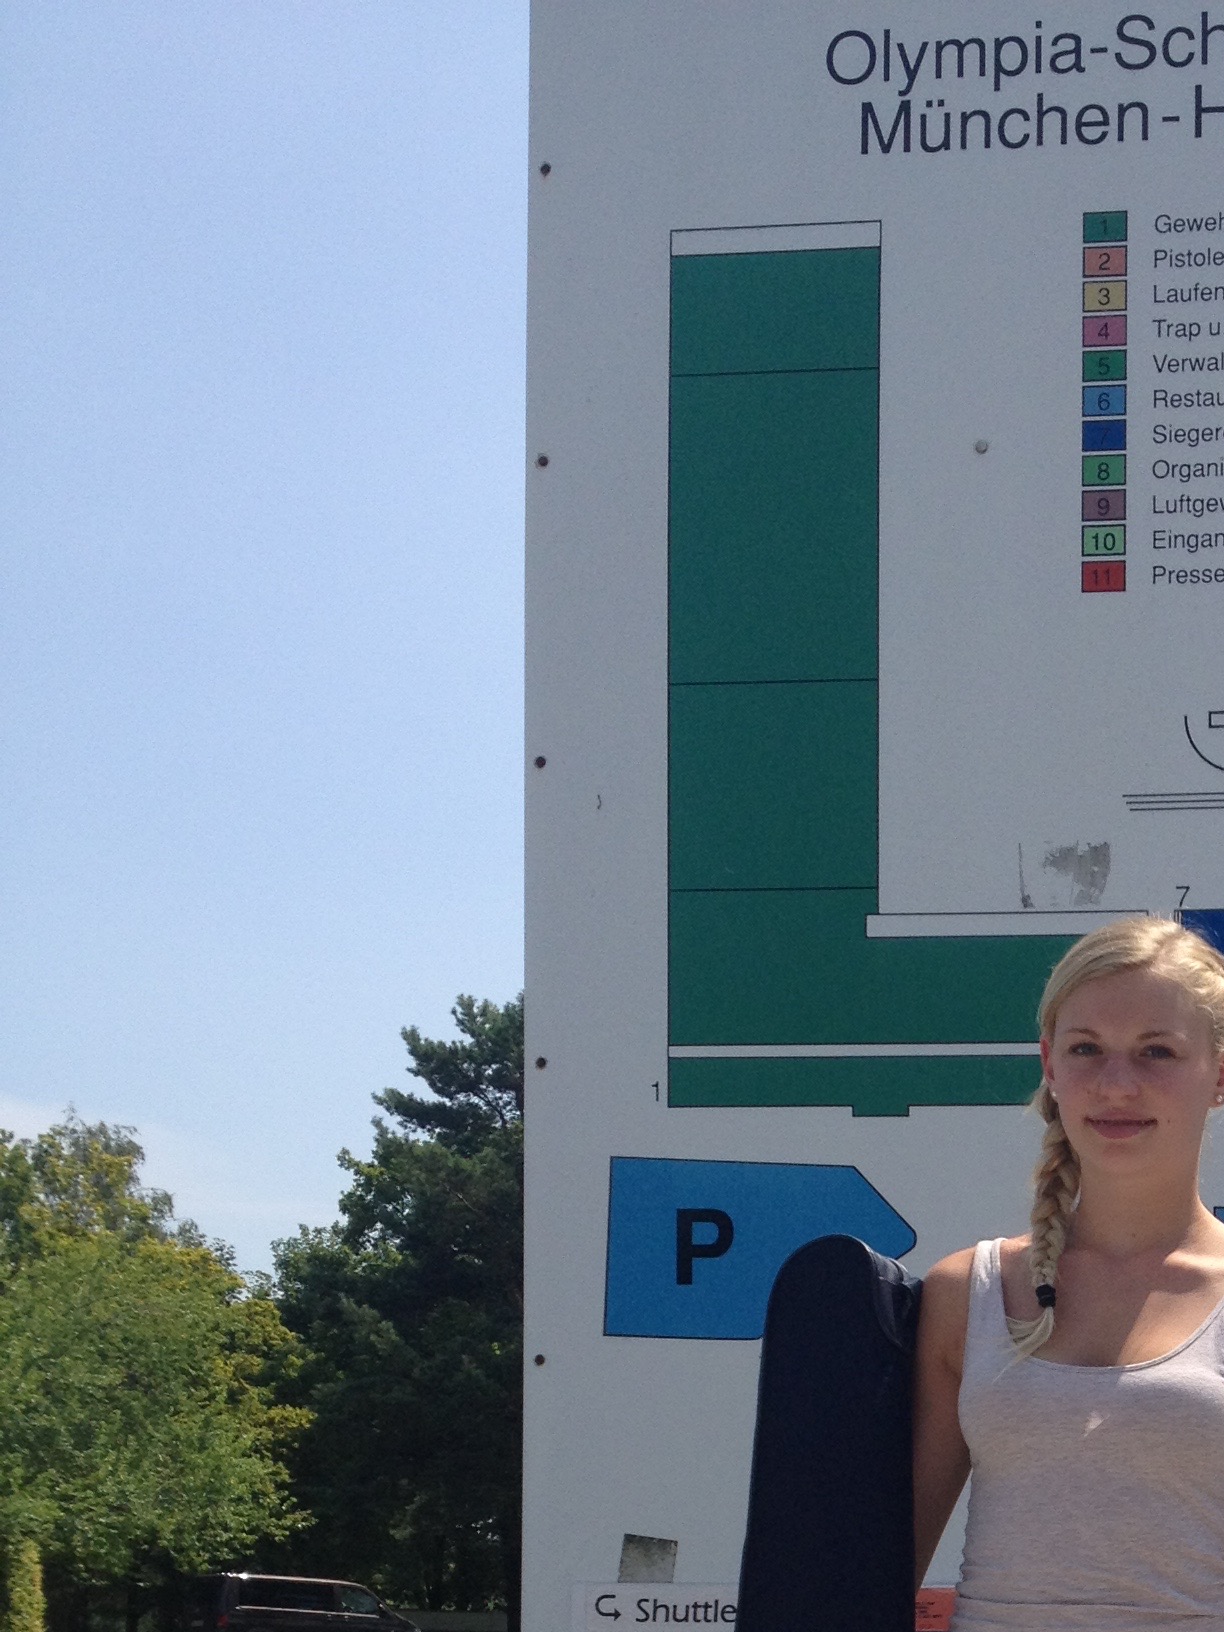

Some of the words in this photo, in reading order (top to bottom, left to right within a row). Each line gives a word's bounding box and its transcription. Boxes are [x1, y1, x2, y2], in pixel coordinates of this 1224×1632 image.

[1100, 219, 1109, 236] 1
[1098, 252, 1111, 271] 2
[1098, 287, 1111, 306] 3
[1098, 322, 1110, 341] 4
[1152, 319, 1201, 342] Trap
[1098, 357, 1110, 376] 5
[1098, 392, 1110, 411] 6
[1097, 462, 1110, 481] 8
[1097, 497, 1110, 516] 9
[1092, 532, 1117, 551] 10
[1092, 568, 1111, 586] 11
[1175, 885, 1191, 907] 7
[651, 1081, 660, 1102] 1
[675, 1207, 734, 1286] P
[635, 1598, 737, 1623] Shuttle
